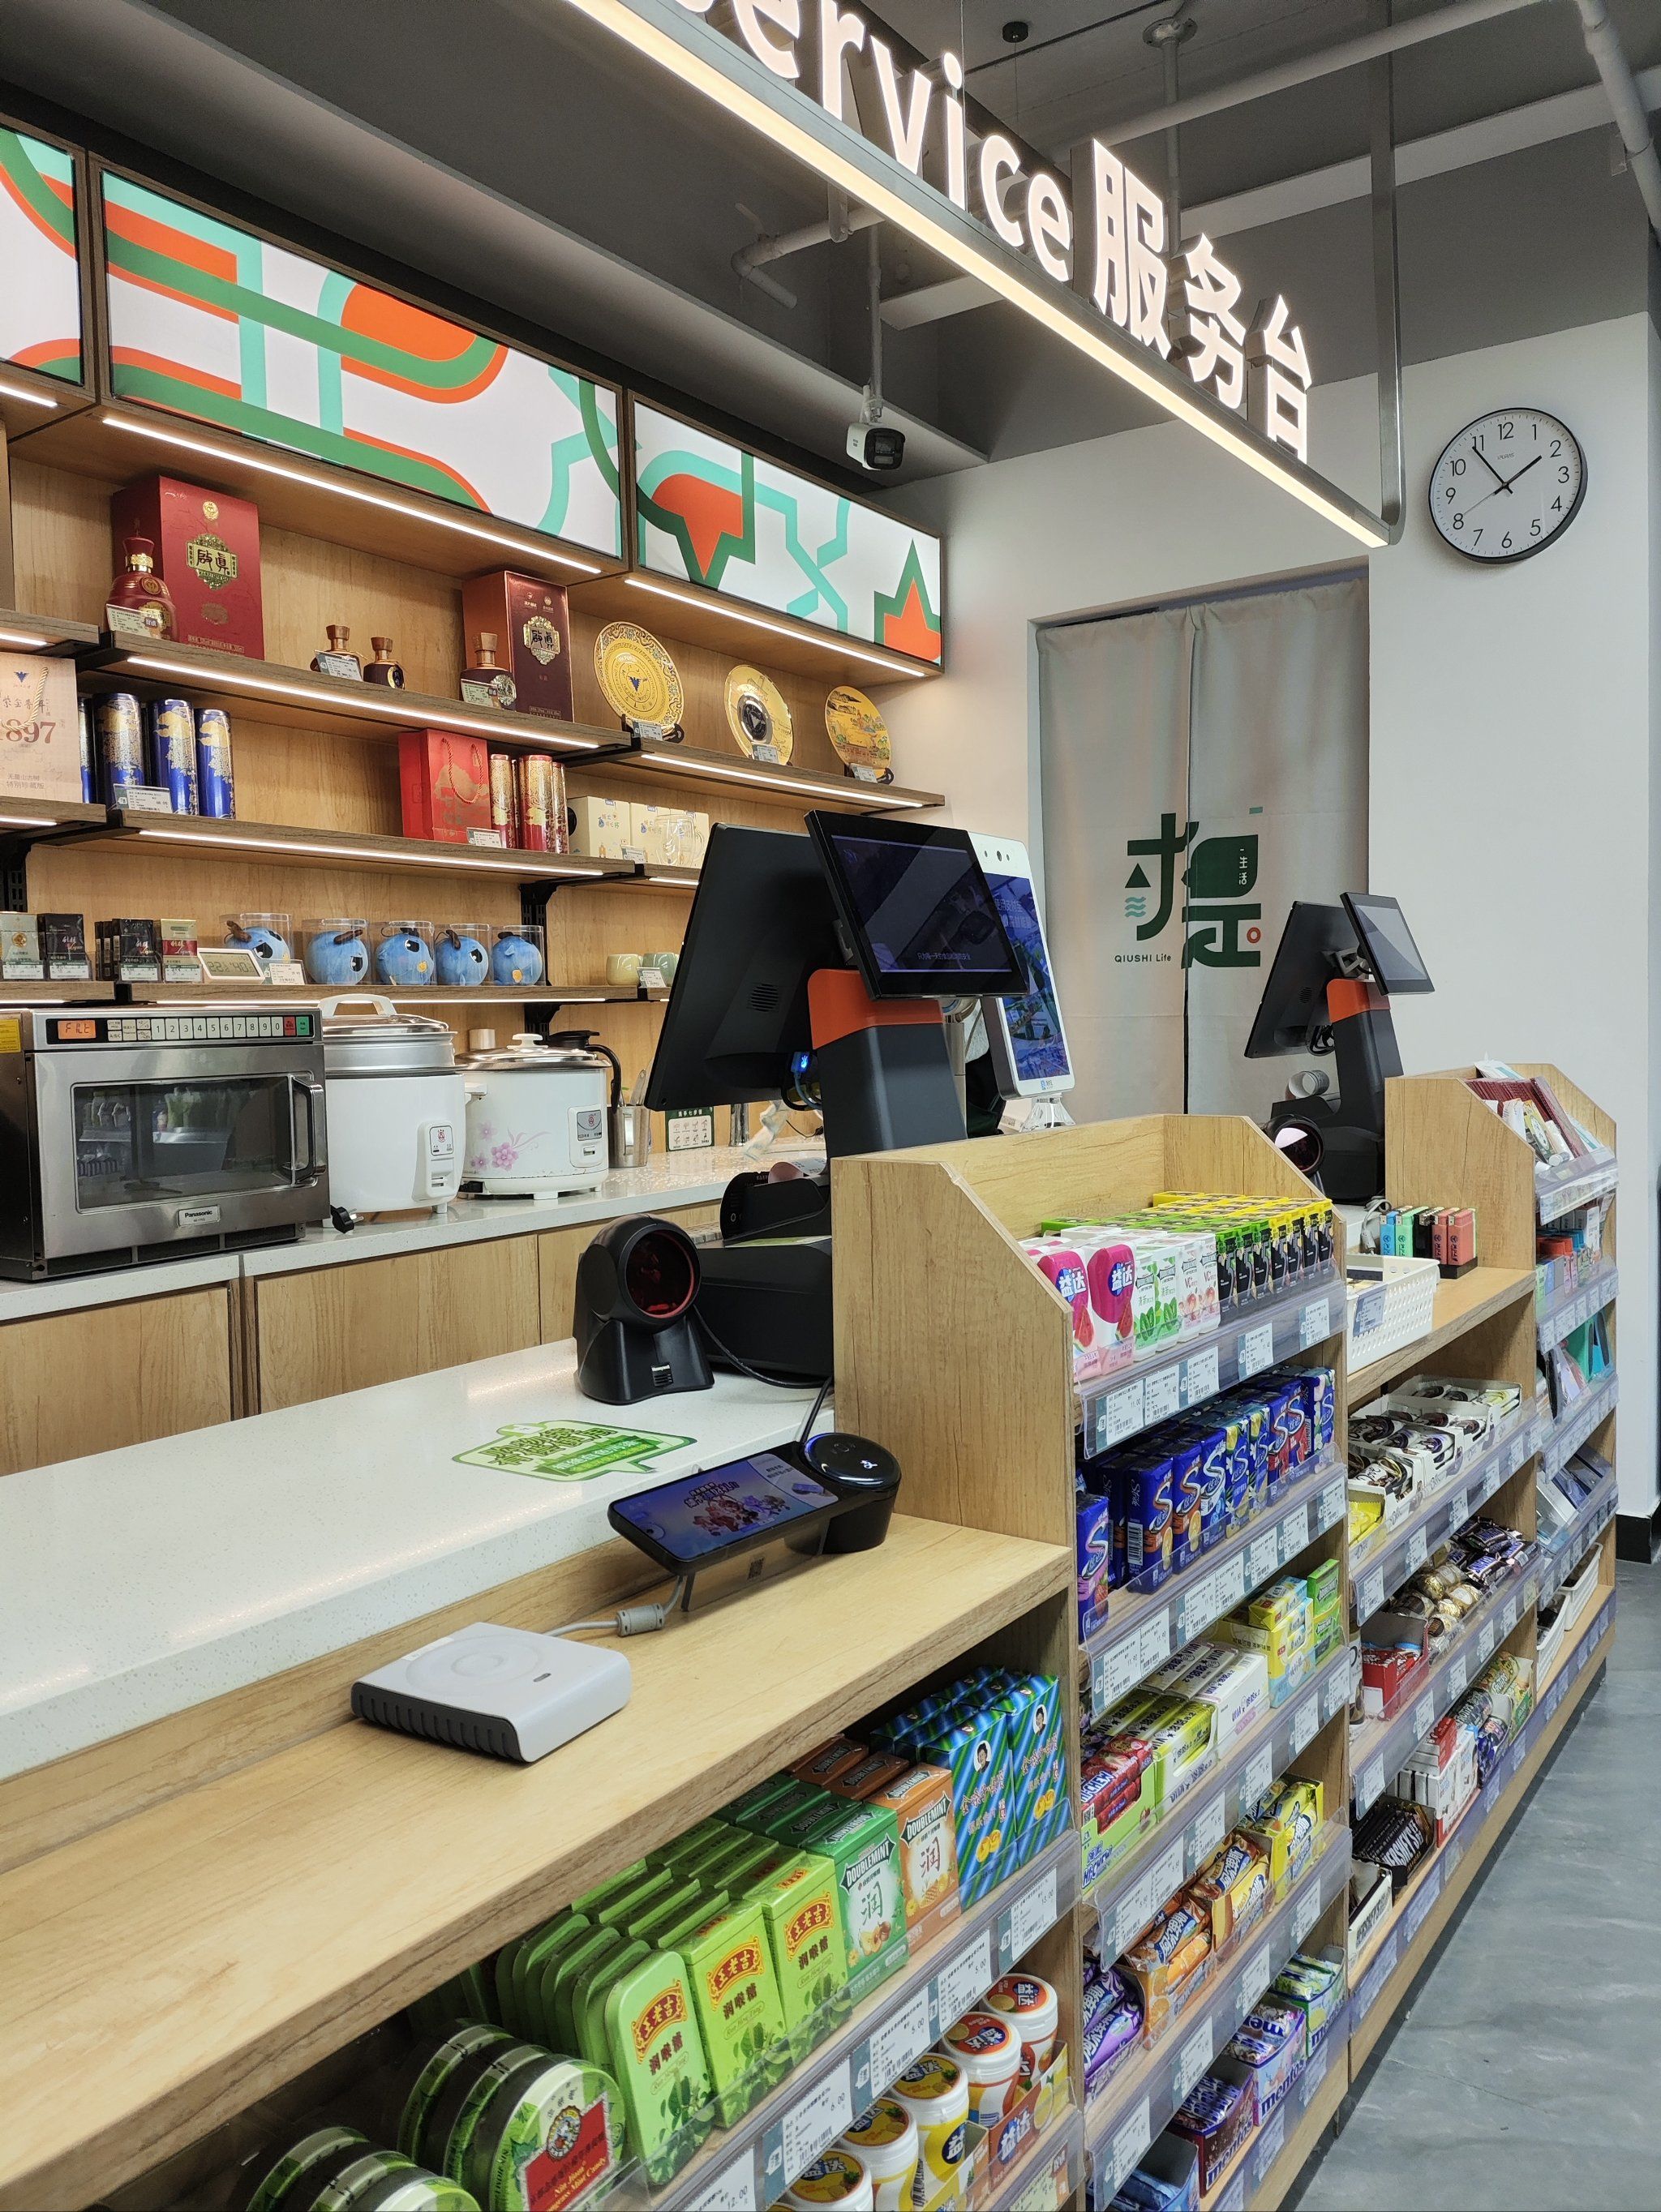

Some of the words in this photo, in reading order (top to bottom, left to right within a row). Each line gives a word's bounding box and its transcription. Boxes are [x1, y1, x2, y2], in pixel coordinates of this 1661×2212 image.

[689, 0, 1071, 282] ervice
[1092, 139, 1311, 465] 服务台
[1498, 422, 1514, 440] 12
[1532, 424, 1537, 440] 1
[1550, 440, 1561, 458] 2
[1450, 459, 1466, 477] 10
[1557, 466, 1569, 483] 3
[1445, 487, 1456, 504] 9
[1551, 495, 1562, 512] 4
[1453, 512, 1464, 529] 8
[1530, 519, 1541, 536] 5
[1474, 529, 1483, 547] 7
[1501, 531, 1512, 548] 6
[0, 718, 56, 744] 897
[1114, 954, 1152, 963] QIUSHI
[1156, 954, 1171, 962] Life
[185, 1210, 212, 1218] Panasonic
[1058, 1267, 1088, 1298] 益达
[1111, 1260, 1135, 1292] 益达
[891, 1772, 929, 1798] DOUBLEMINT
[906, 1797, 947, 1841] DOUBLEMINT
[845, 1840, 890, 1888] DOUBLEMINT
[920, 1837, 941, 1877] 润
[861, 1880, 883, 1925] 润
[792, 1905, 825, 1937] 王老吉
[797, 1935, 829, 1970] 润喉糖
[717, 1952, 756, 1985] 王老吉
[975, 1958, 987, 1974] 5.00
[722, 1983, 758, 2021] 润喉糖
[1017, 1982, 1039, 2007] 益达
[640, 1996, 676, 2034] 王老吉
[911, 2017, 925, 2034] 5.00
[966, 2026, 1004, 2050] 益达
[648, 2031, 685, 2076] 润喉糖
[830, 2092, 845, 2111] 6.00
[1000, 2109, 1031, 2161] 益达
[727, 2185, 749, 2210] 12.00
